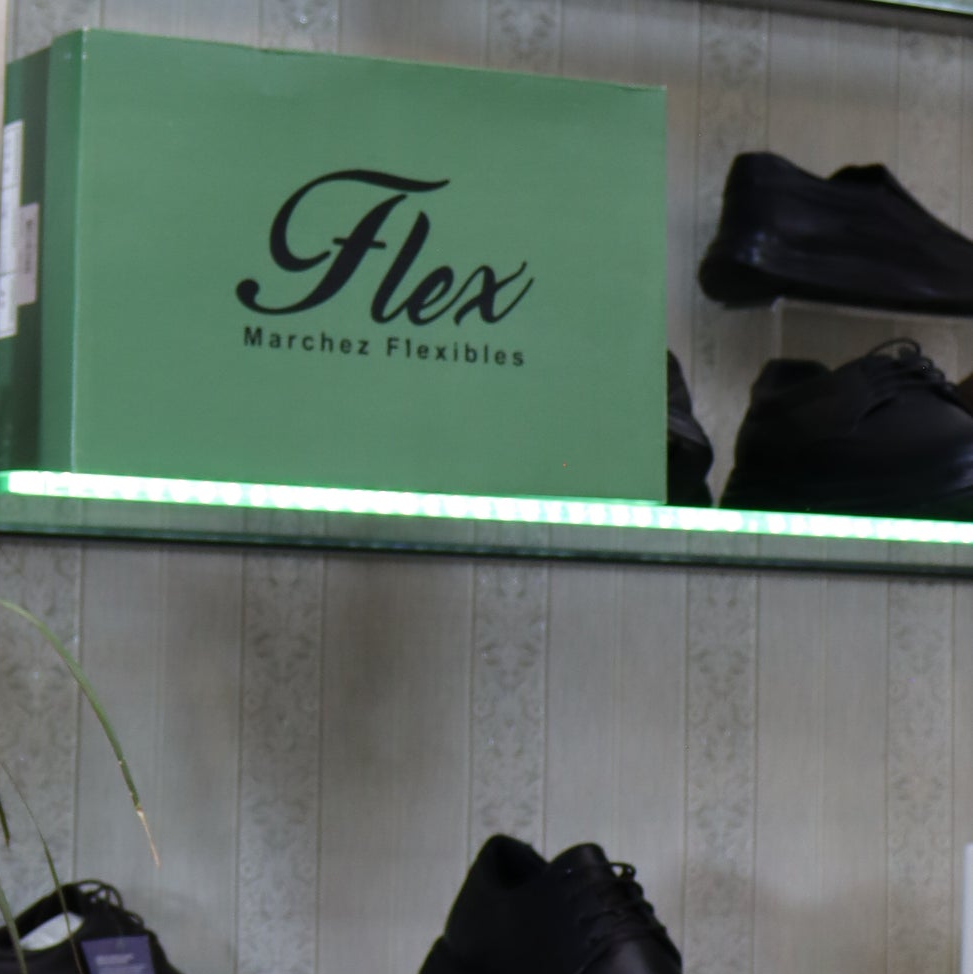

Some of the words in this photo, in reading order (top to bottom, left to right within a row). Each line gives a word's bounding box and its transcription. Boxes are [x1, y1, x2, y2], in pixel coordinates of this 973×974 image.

[235, 168, 534, 326] Flex
[243, 325, 370, 356] Marchez
[386, 336, 525, 367] Flexibles
